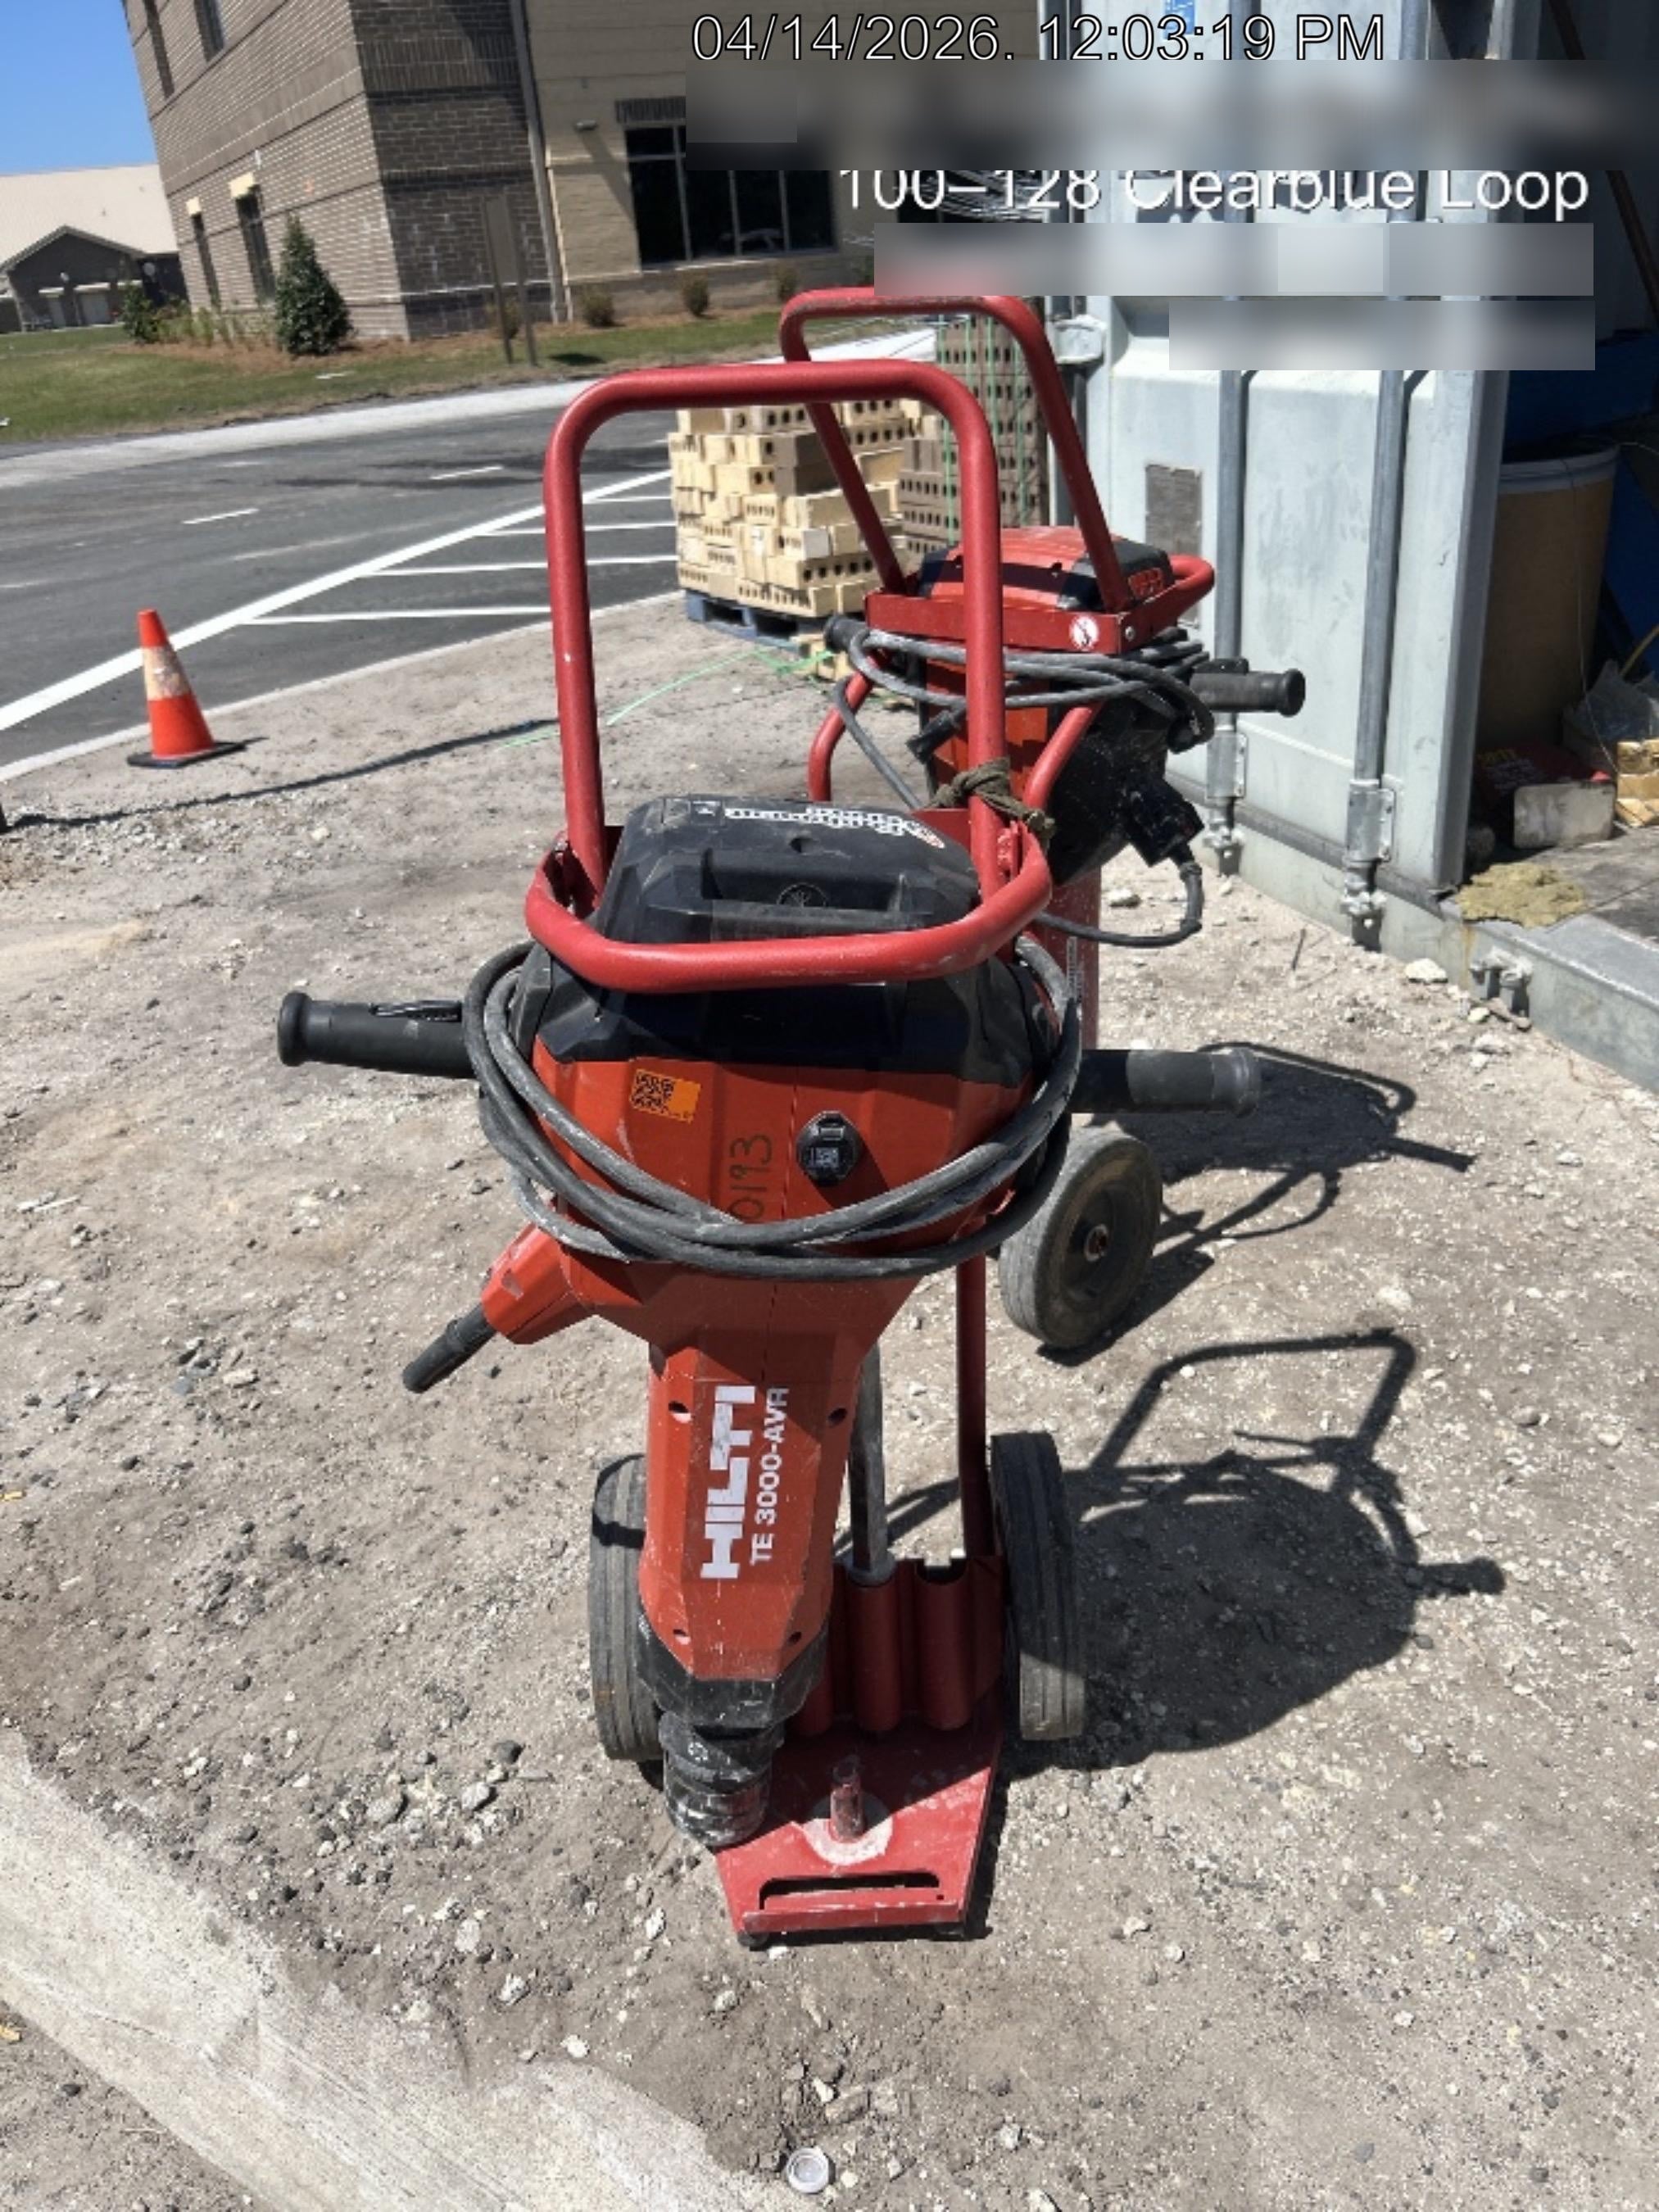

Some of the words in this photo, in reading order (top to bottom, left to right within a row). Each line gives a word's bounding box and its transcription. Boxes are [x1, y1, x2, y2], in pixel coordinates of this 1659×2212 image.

[700, 1385, 755, 1579] HILTI
[755, 1388, 789, 1526] 3000-AVR
[750, 1533, 774, 1566] TE
